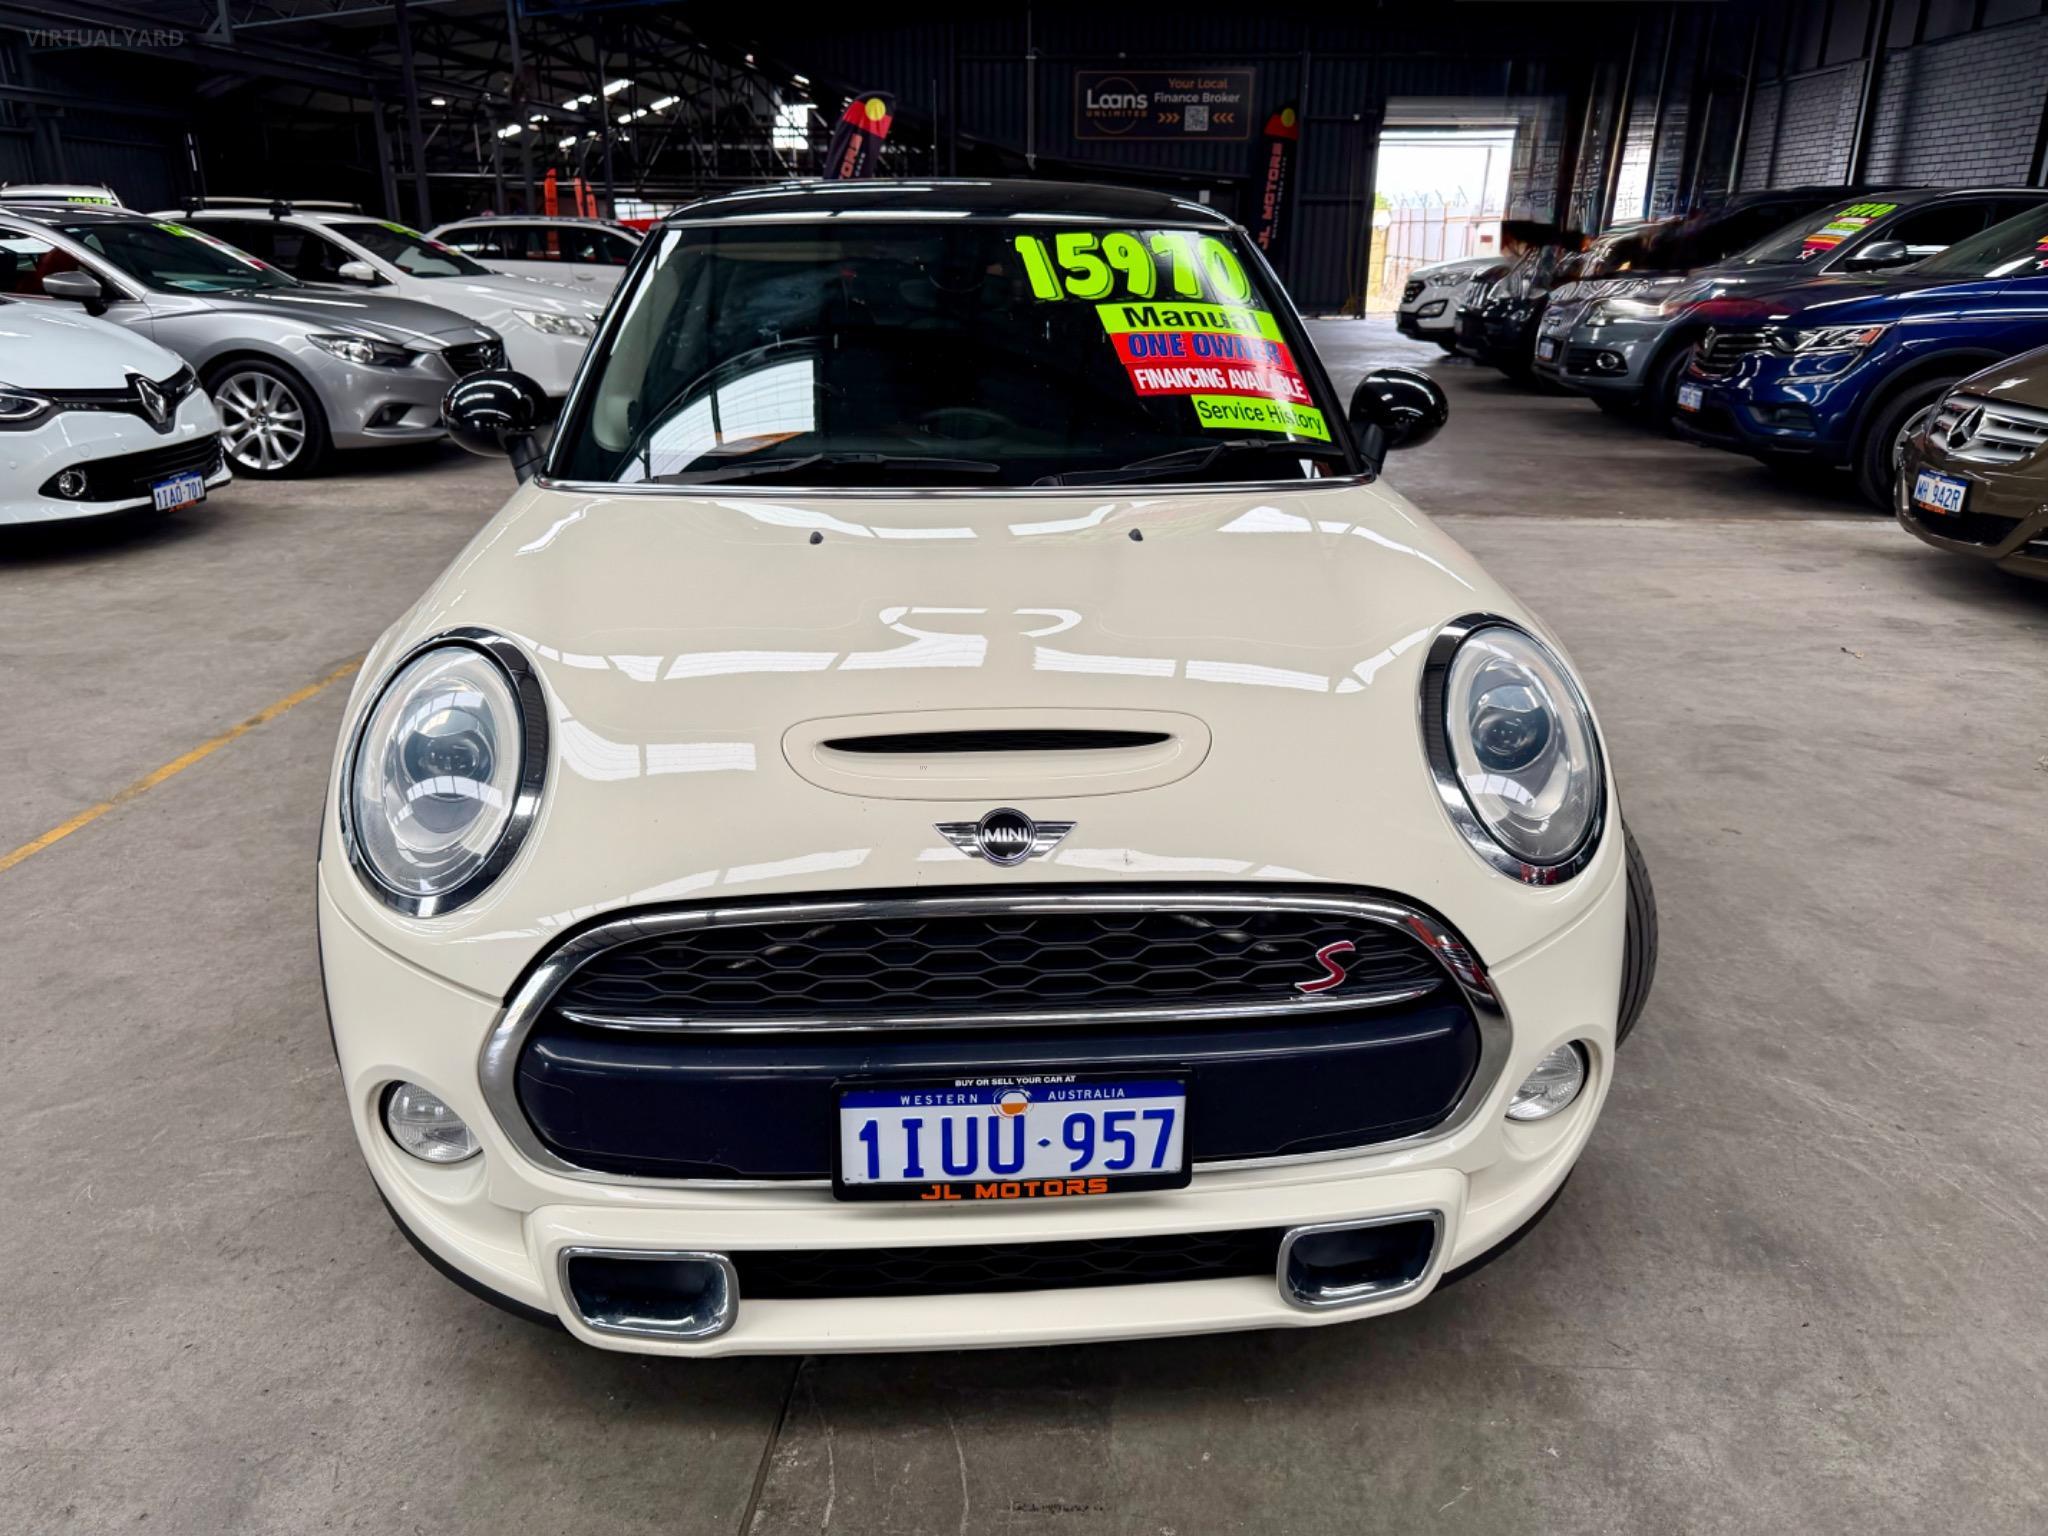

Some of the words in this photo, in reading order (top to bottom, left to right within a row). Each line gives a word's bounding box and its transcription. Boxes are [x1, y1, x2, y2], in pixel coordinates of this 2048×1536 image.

[1168, 78, 1195, 89] Your
[1198, 78, 1228, 89] Local
[1087, 89, 1148, 109] Loans
[1154, 92, 1199, 103] Finance
[1202, 92, 1240, 103] Broker
[1261, 142, 1284, 220] MOTORS
[1015, 233, 1251, 301] 15970
[1122, 306, 1262, 334] Manual
[1128, 333, 1187, 358] ONE
[1191, 333, 1281, 365] OWNER
[1134, 367, 1228, 391] FINANCING
[1227, 369, 1308, 399] AVAILABLE
[1197, 400, 1265, 421] Service
[1266, 404, 1322, 435] History
[983, 827, 1029, 842] MINI
[1294, 940, 1356, 993] S
[955, 1079, 974, 1087] BUY
[976, 1079, 989, 1087] OR
[1016, 1076, 1042, 1084] YOUR
[1043, 1075, 1063, 1083] CAR
[1064, 1075, 1077, 1083] AT
[901, 1094, 978, 1105] WESTERN
[1047, 1088, 1126, 1101] AUSTRALIA
[921, 1184, 962, 1200] JL
[975, 1178, 1109, 1199] MOTORS
